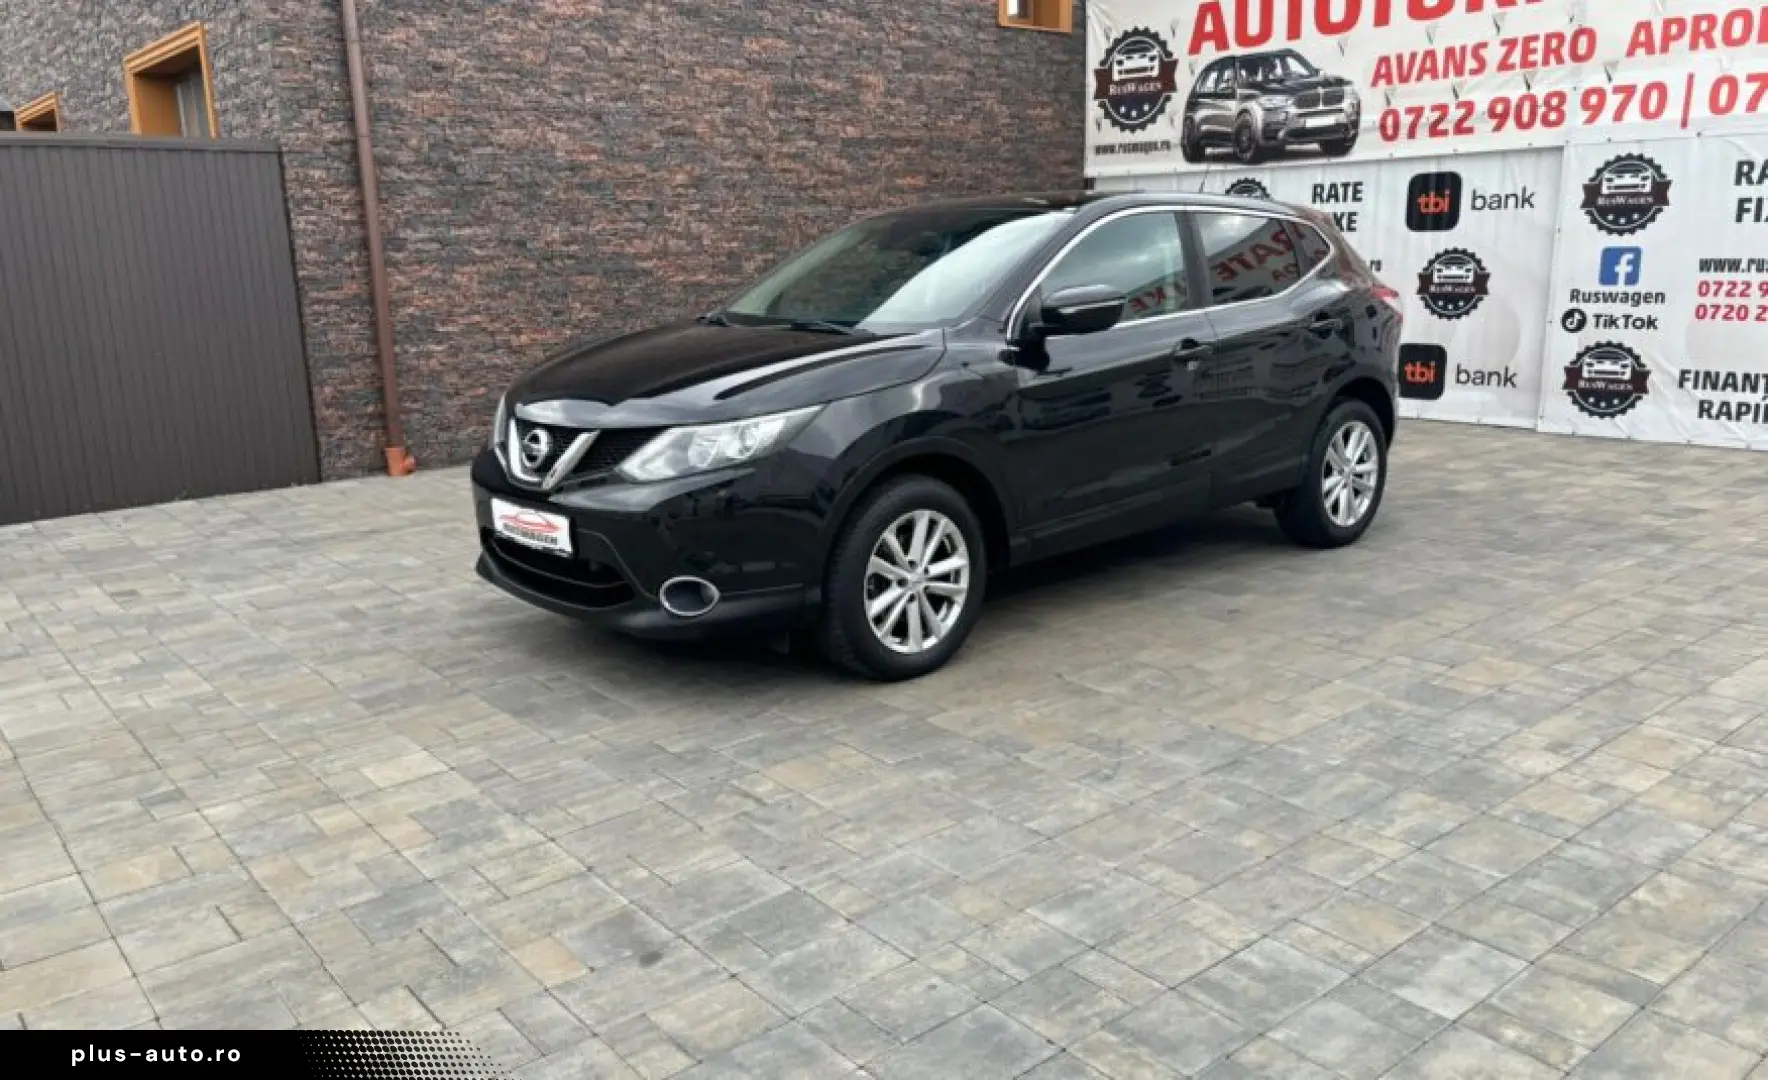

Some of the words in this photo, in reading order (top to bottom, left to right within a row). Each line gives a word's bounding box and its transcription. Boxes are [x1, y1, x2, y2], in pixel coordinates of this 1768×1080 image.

[1371, 42, 1488, 88] AVANS
[1497, 27, 1597, 71] ZERO
[1379, 100, 1475, 142] 0722
[1487, 90, 1567, 132] 908
[1580, 81, 1668, 126] 970
[1708, 72, 1768, 115] 07
[1312, 182, 1363, 204] RATE
[1417, 192, 1451, 214] tbi
[1471, 187, 1535, 211] bank
[1735, 197, 1768, 223] FI
[1570, 289, 1666, 306] Ruswagen
[1698, 280, 1752, 298] 0722
[1593, 314, 1658, 330] TikTok
[1695, 304, 1749, 321] 0720
[1404, 362, 1436, 383] tbi
[1456, 364, 1517, 388] bank
